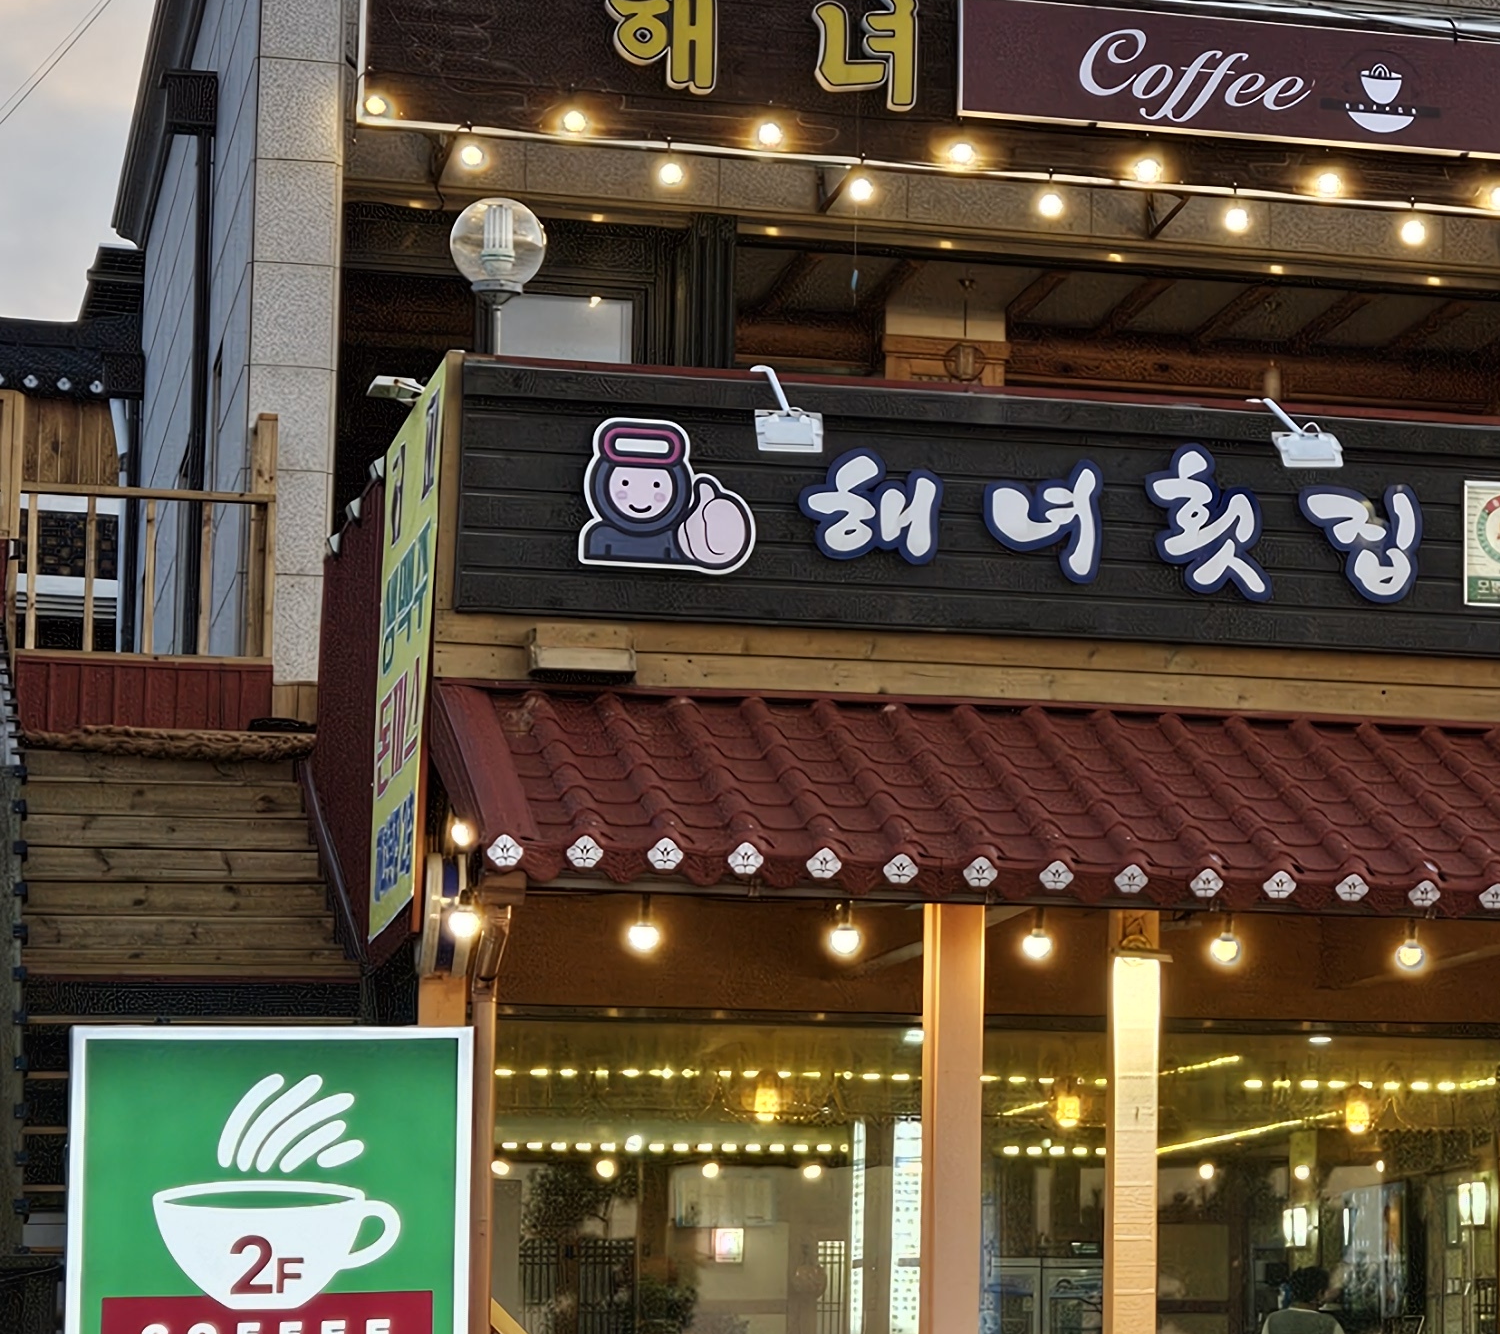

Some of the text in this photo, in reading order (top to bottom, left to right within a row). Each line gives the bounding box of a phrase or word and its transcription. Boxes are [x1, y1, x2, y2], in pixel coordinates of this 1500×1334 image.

[1078, 28, 1316, 123] Coffee
[802, 445, 1420, 602] 해녀횟집
[377, 655, 421, 800] 돈까스
[230, 1235, 304, 1295] 2F
